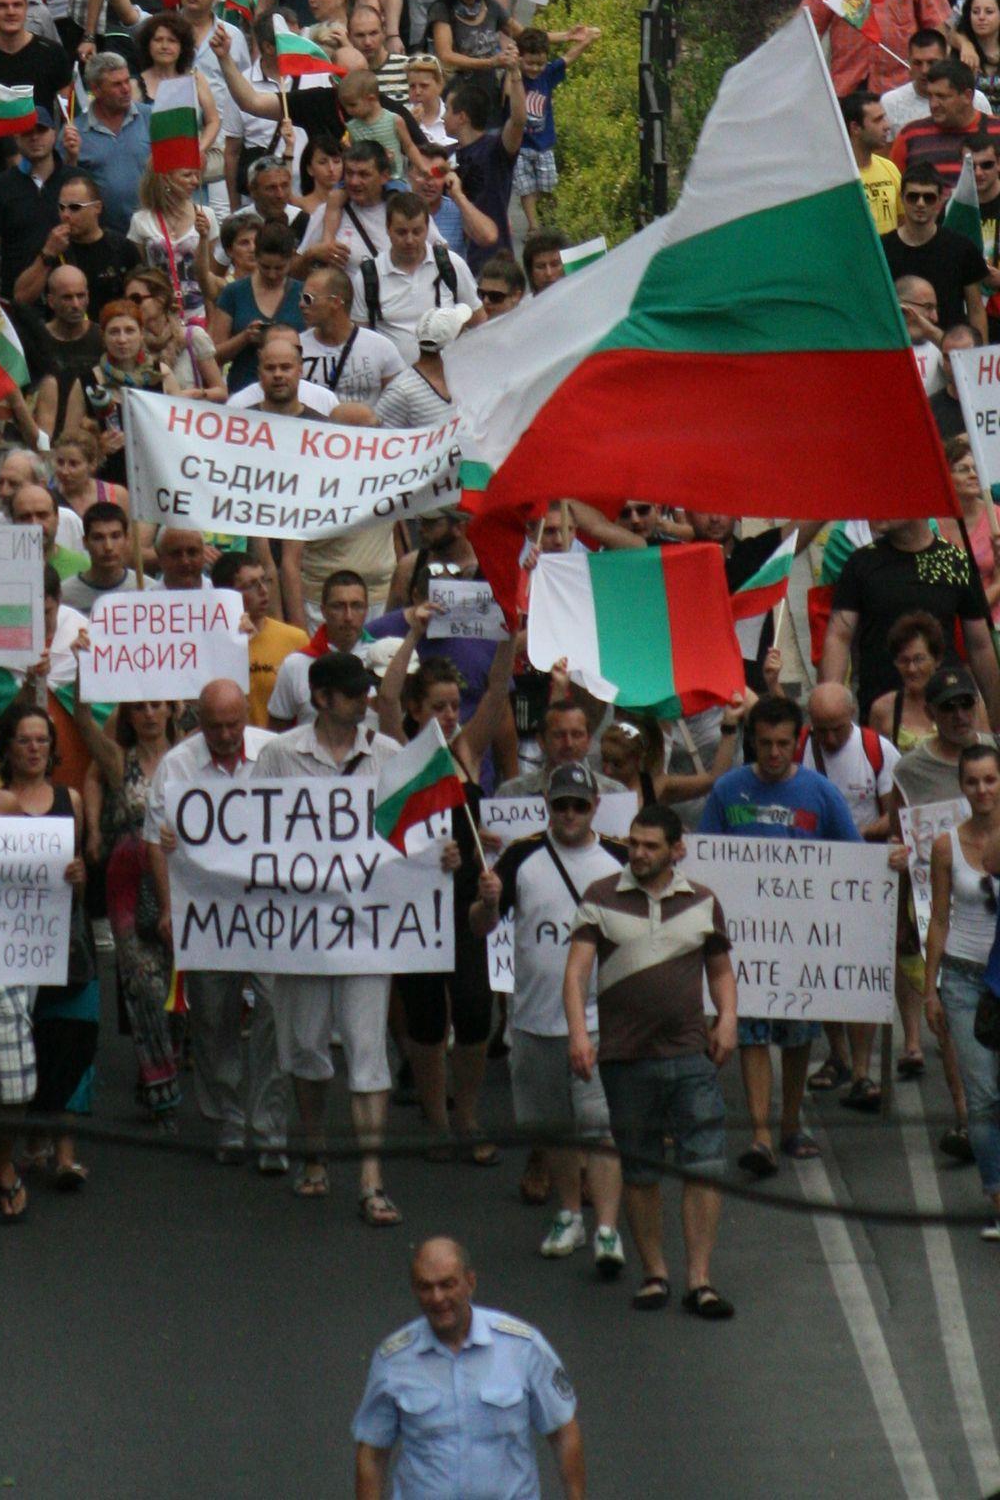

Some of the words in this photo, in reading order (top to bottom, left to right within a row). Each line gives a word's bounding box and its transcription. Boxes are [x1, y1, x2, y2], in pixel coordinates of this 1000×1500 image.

[167, 405, 276, 452] НОВА
[299, 416, 466, 462] КОНСТИТ
[180, 454, 299, 497] СЪДИИ
[318, 476, 342, 500] И
[156, 487, 193, 517] СЕ
[211, 494, 360, 530] ИЗБИРАТ
[372, 491, 414, 519] ОТ
[91, 602, 230, 636] ЧЕРВЕНА
[93, 642, 198, 675] МАФИЯ
[486, 805, 546, 826] ДОЛУ
[696, 840, 832, 867] СИНДИКАТИ
[244, 851, 381, 894] ДОЛУ
[830, 879, 873, 903] СТЕ
[10, 913, 62, 938] ДПС
[180, 888, 445, 951] МАФИЯТА!
[726, 916, 794, 945] ОЙНА
[807, 922, 842, 948] ЛИ
[798, 963, 827, 990] ДА
[834, 964, 893, 993] СТАНЕ
